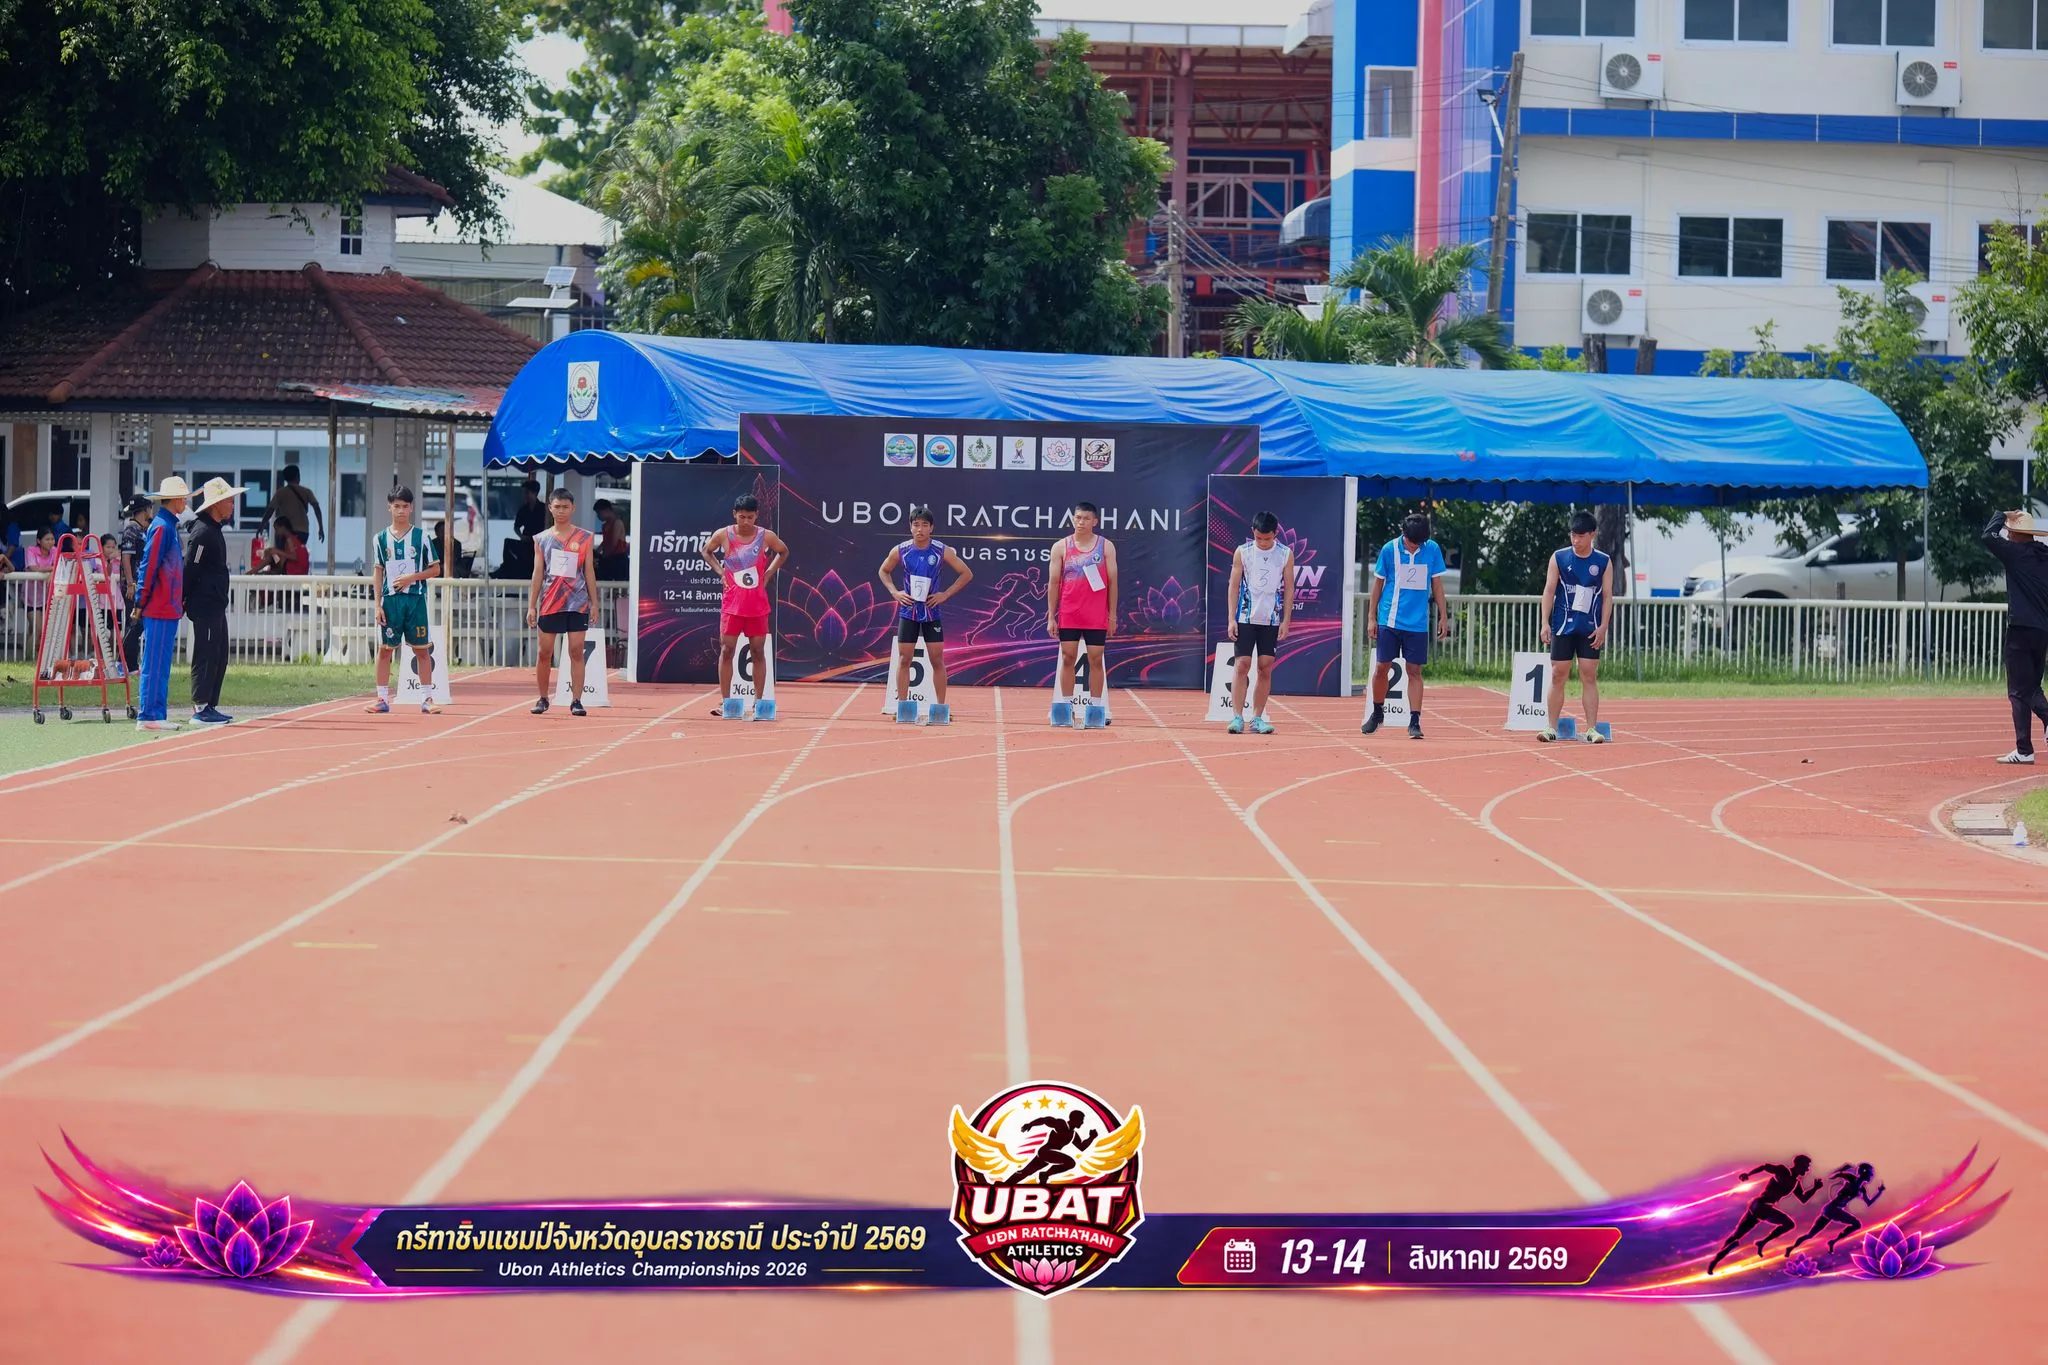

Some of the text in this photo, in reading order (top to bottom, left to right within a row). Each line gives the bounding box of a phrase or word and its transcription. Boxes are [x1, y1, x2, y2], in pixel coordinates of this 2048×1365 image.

[822, 501, 1180, 531] UBO RATCHAHANI
[558, 556, 569, 570] 7
[742, 573, 754, 586] 6
[1258, 568, 1270, 588] 3
[1406, 567, 1417, 583] 2
[695, 590, 723, 600] สิงหาค
[914, 580, 926, 597] 5
[416, 626, 427, 638] 13
[1385, 661, 1403, 699] 2
[1525, 664, 1544, 703] 1
[732, 684, 756, 696] Nelc
[1382, 703, 1404, 714] elco
[1516, 704, 1546, 717] Nelco
